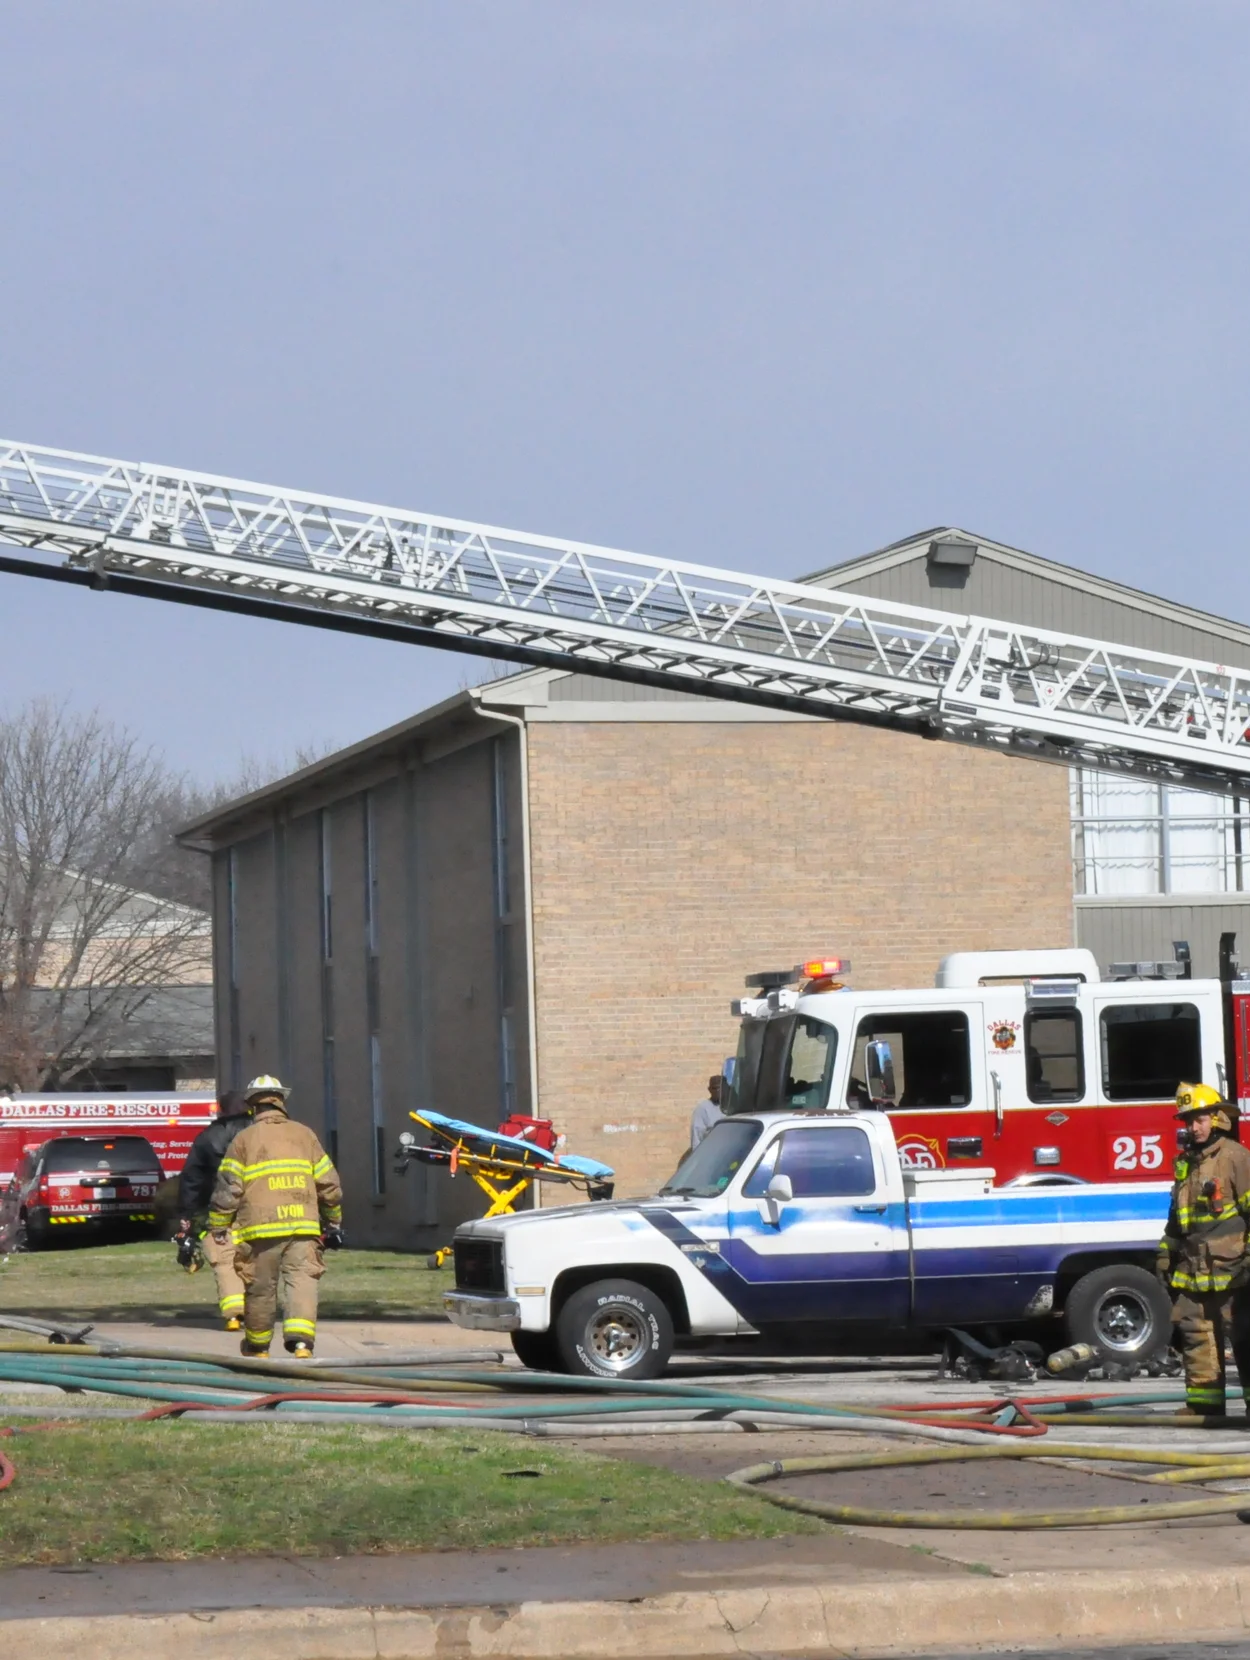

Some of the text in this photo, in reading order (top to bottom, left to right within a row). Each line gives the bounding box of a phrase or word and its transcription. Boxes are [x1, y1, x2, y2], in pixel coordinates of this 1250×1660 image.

[987, 1019, 1021, 1031] DALLAS
[1, 1103, 180, 1117] DALLAS FIRE-RESCUE
[1113, 1135, 1163, 1170] 25
[268, 1175, 306, 1190] DALLAS
[131, 1185, 157, 1197] 781
[51, 1203, 89, 1212] DALLAS
[276, 1204, 304, 1219] LYON
[597, 1294, 645, 1312] RADIAL
